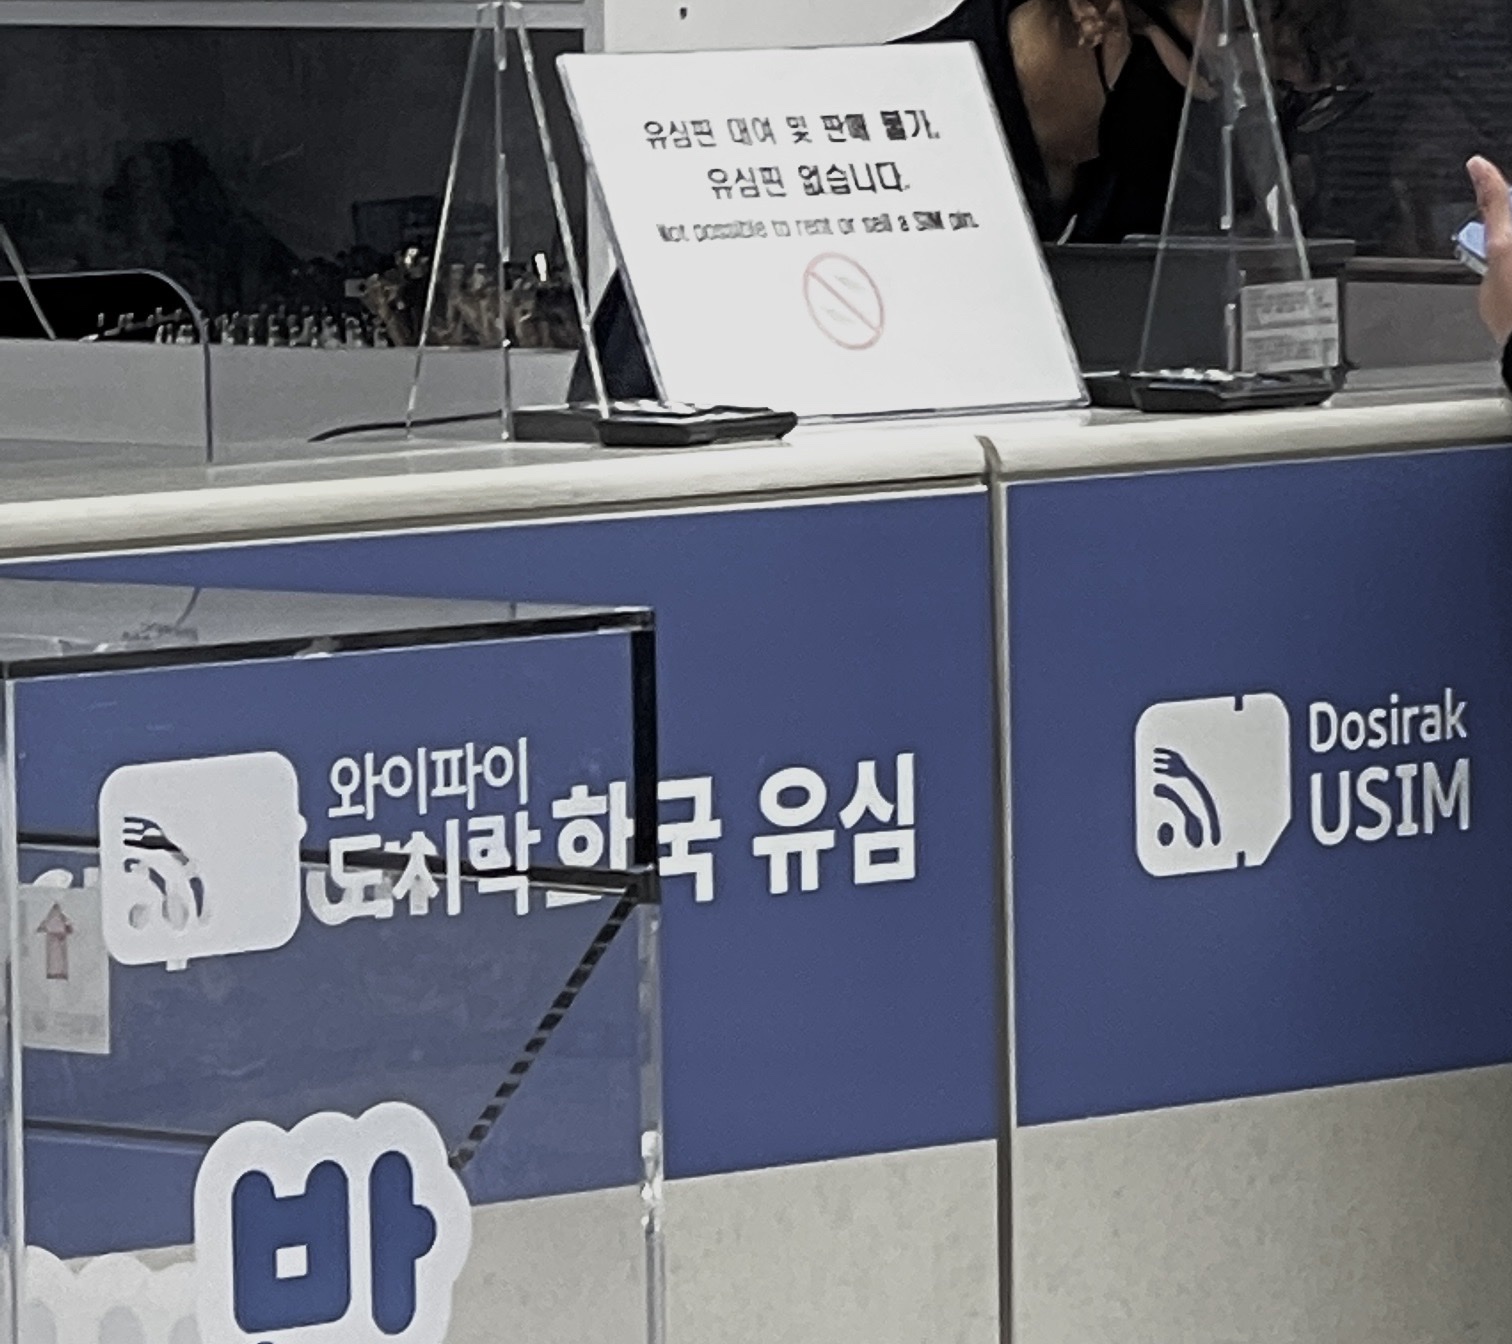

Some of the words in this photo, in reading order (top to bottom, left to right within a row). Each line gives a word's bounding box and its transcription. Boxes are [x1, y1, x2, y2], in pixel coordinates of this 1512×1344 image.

[644, 120, 717, 150] 유심핀
[727, 116, 777, 146] 대여
[822, 113, 870, 143] 판매
[708, 166, 788, 199] 유심핀
[798, 161, 911, 197] 없습니다.
[1310, 688, 1468, 753] Dosirak
[328, 737, 528, 821] 와이파이
[1311, 758, 1470, 846] USIM
[546, 776, 722, 909] 한국
[752, 752, 918, 895] 유심
